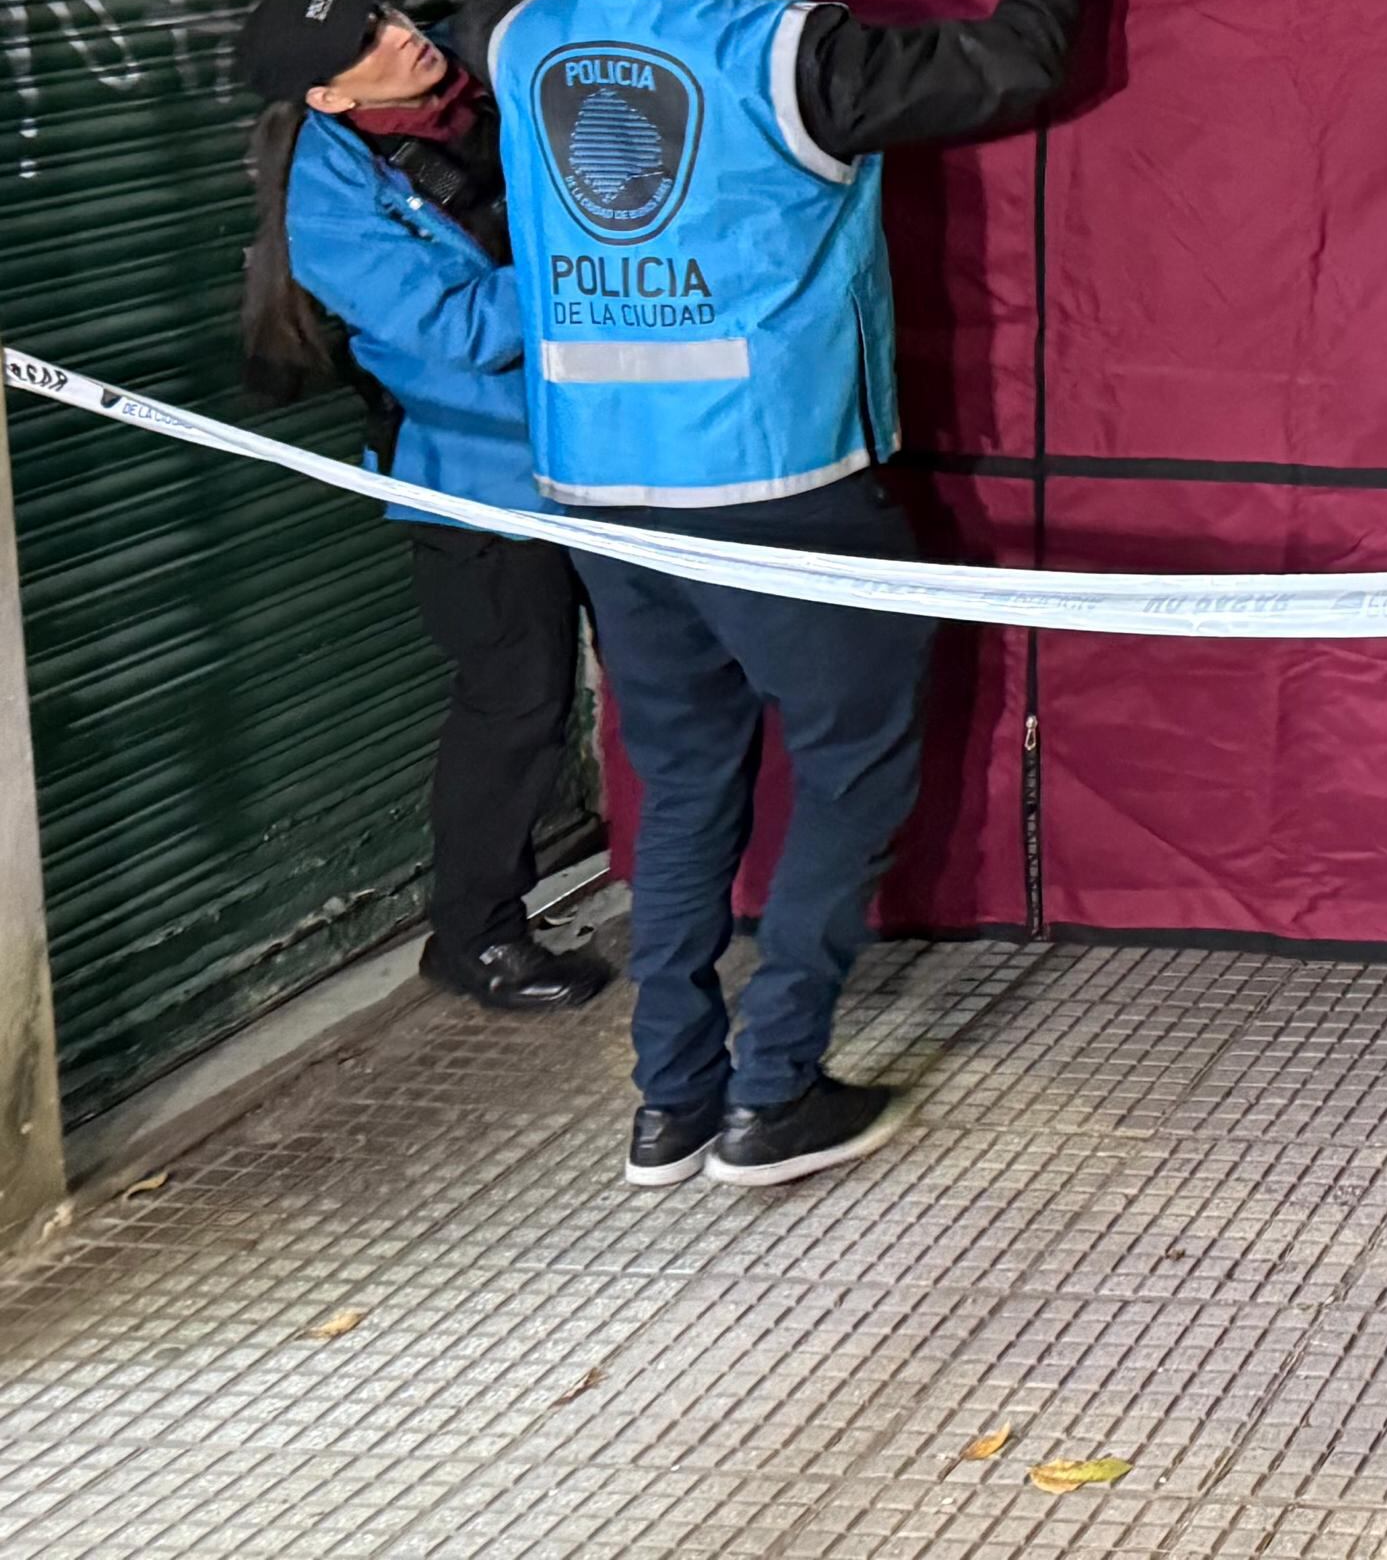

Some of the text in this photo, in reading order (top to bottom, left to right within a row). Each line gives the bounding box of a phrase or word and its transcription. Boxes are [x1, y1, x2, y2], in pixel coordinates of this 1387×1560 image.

[565, 60, 656, 90] POLICIA
[551, 254, 712, 298] POLICIA
[553, 302, 715, 328] DE LA CIUDAD
[122, 402, 138, 417] DE
